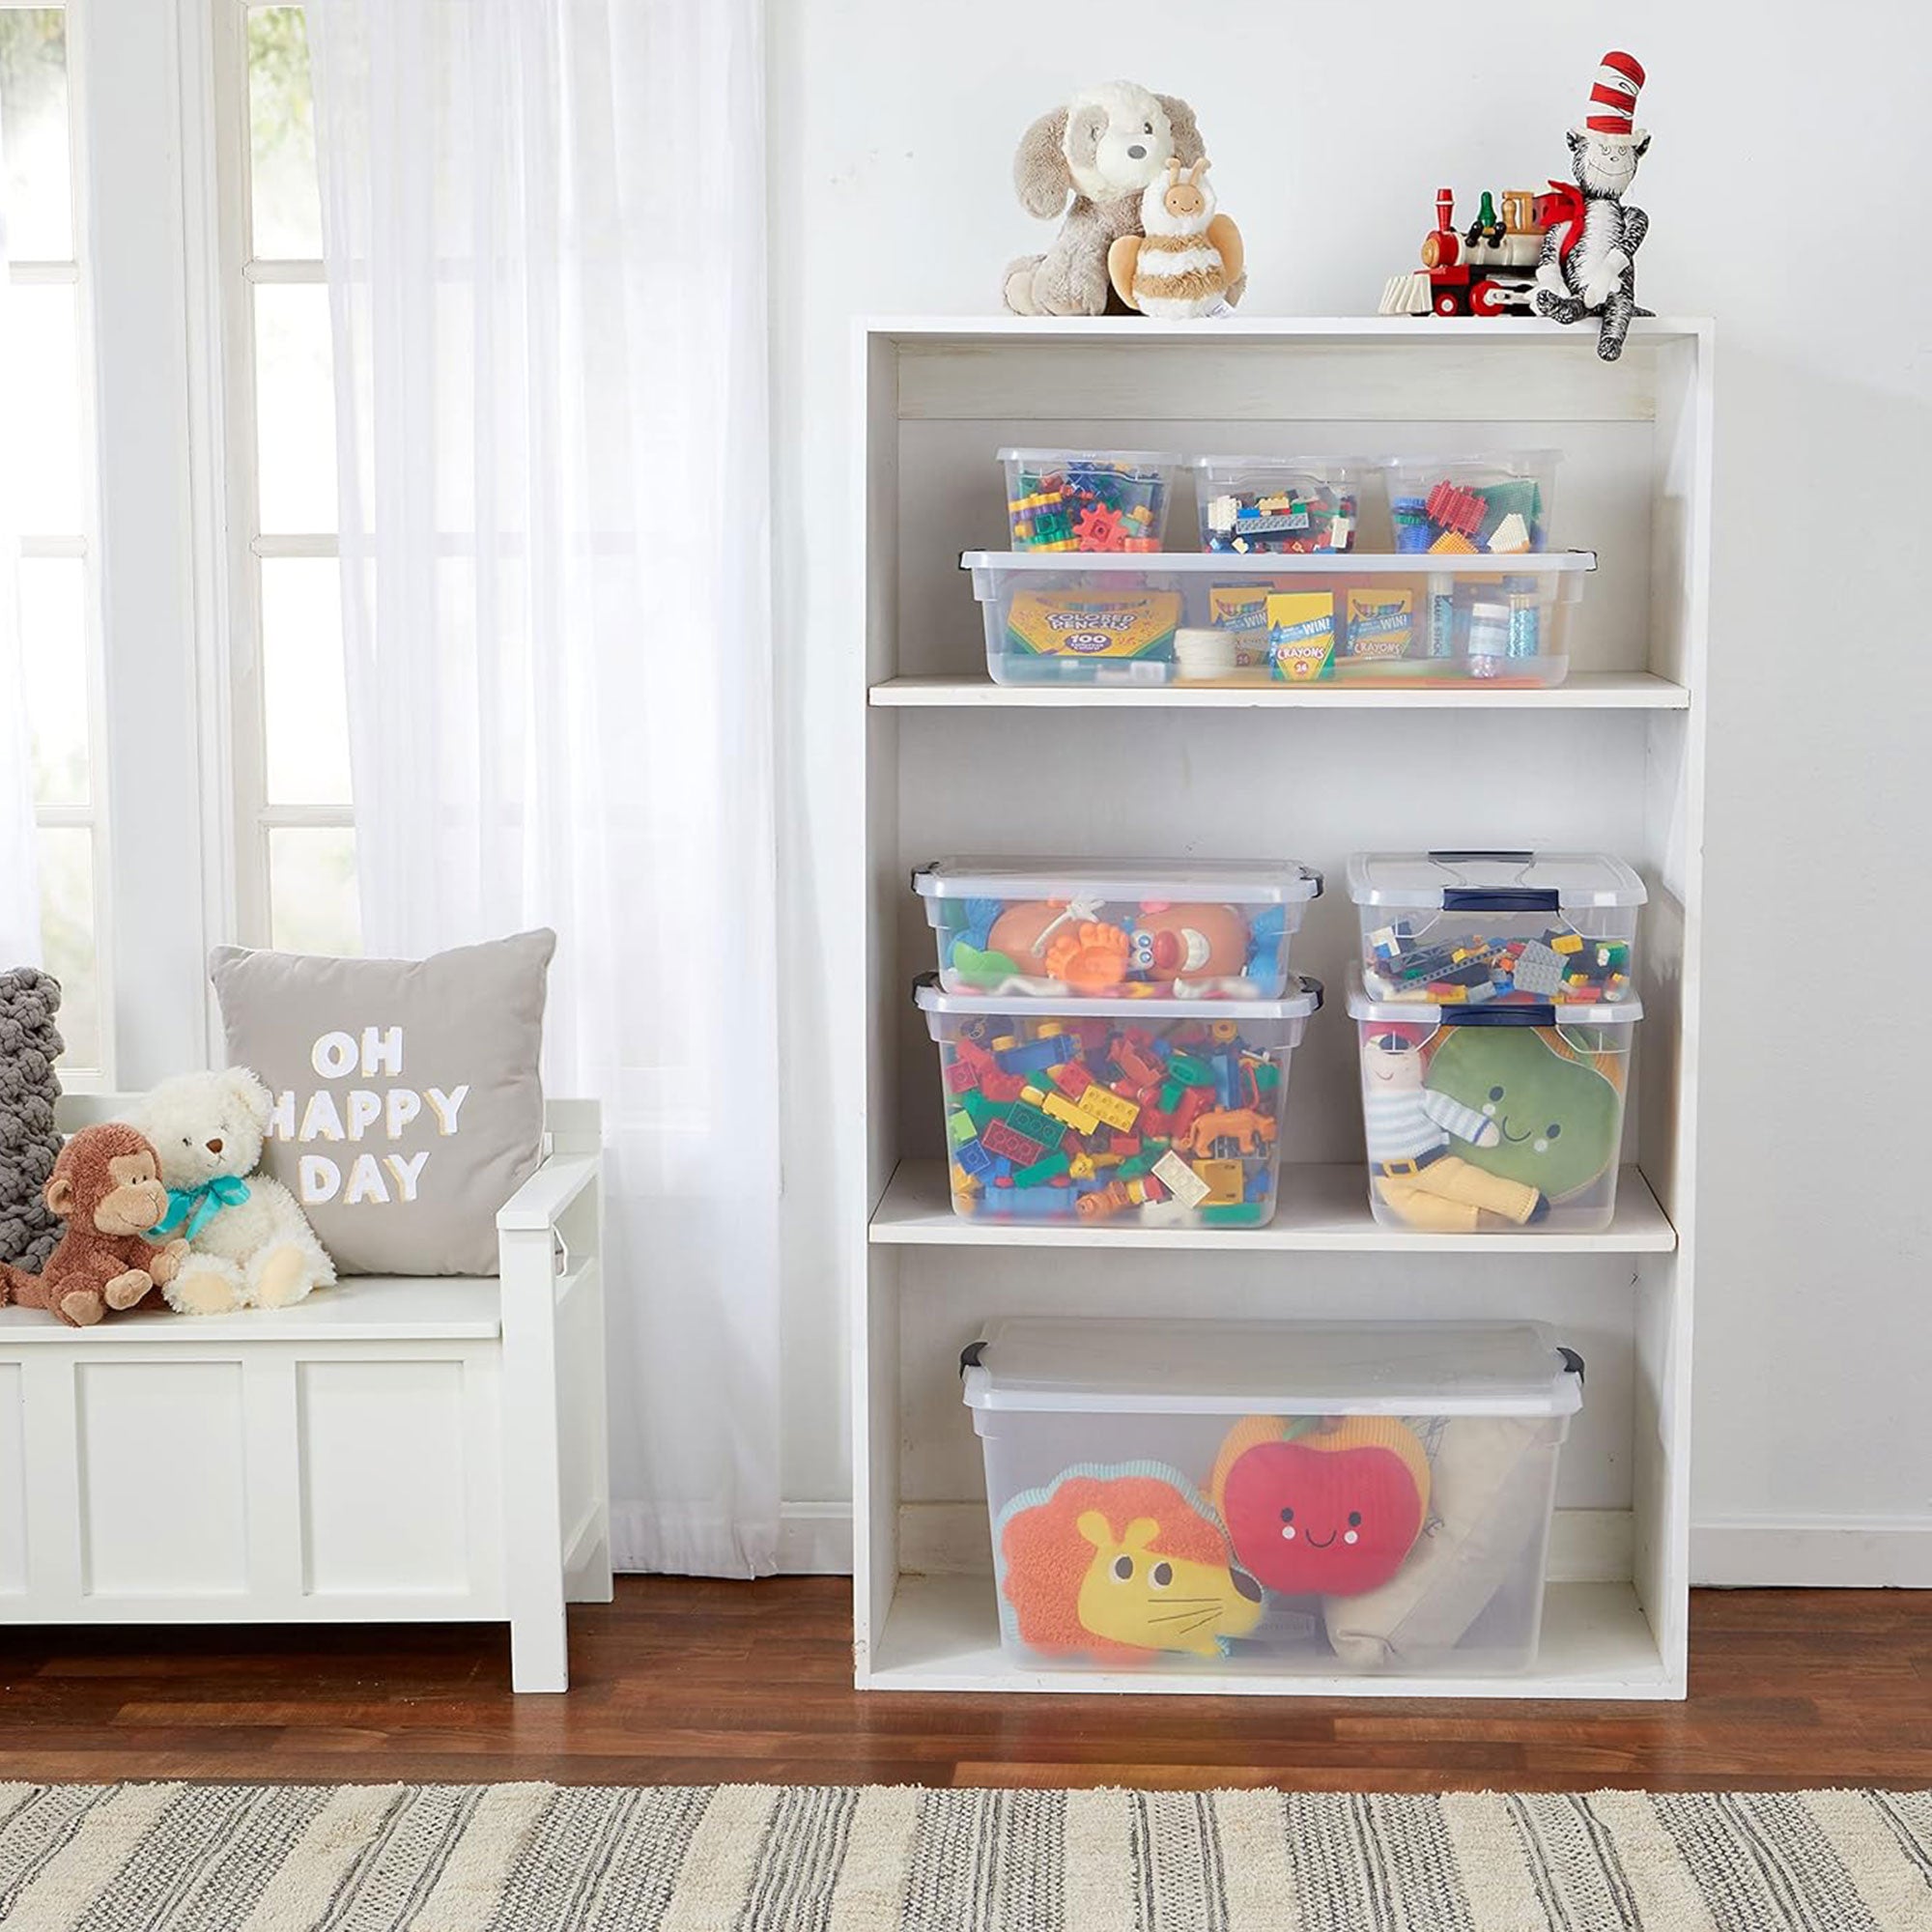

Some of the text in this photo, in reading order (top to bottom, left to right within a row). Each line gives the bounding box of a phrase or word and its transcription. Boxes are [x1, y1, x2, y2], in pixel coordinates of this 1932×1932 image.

[1046, 613, 1136, 622] COLORED
[1379, 614, 1407, 630] WIN!
[1051, 620, 1128, 631] PENCILS
[1302, 618, 1331, 636] WIN!
[1070, 634, 1107, 643] 100
[1276, 647, 1324, 661] CRAYONS
[1354, 641, 1401, 655] CRAYONS
[311, 1026, 403, 1079] OH
[263, 1085, 470, 1142] HAPPY
[298, 1151, 430, 1206] DAY
